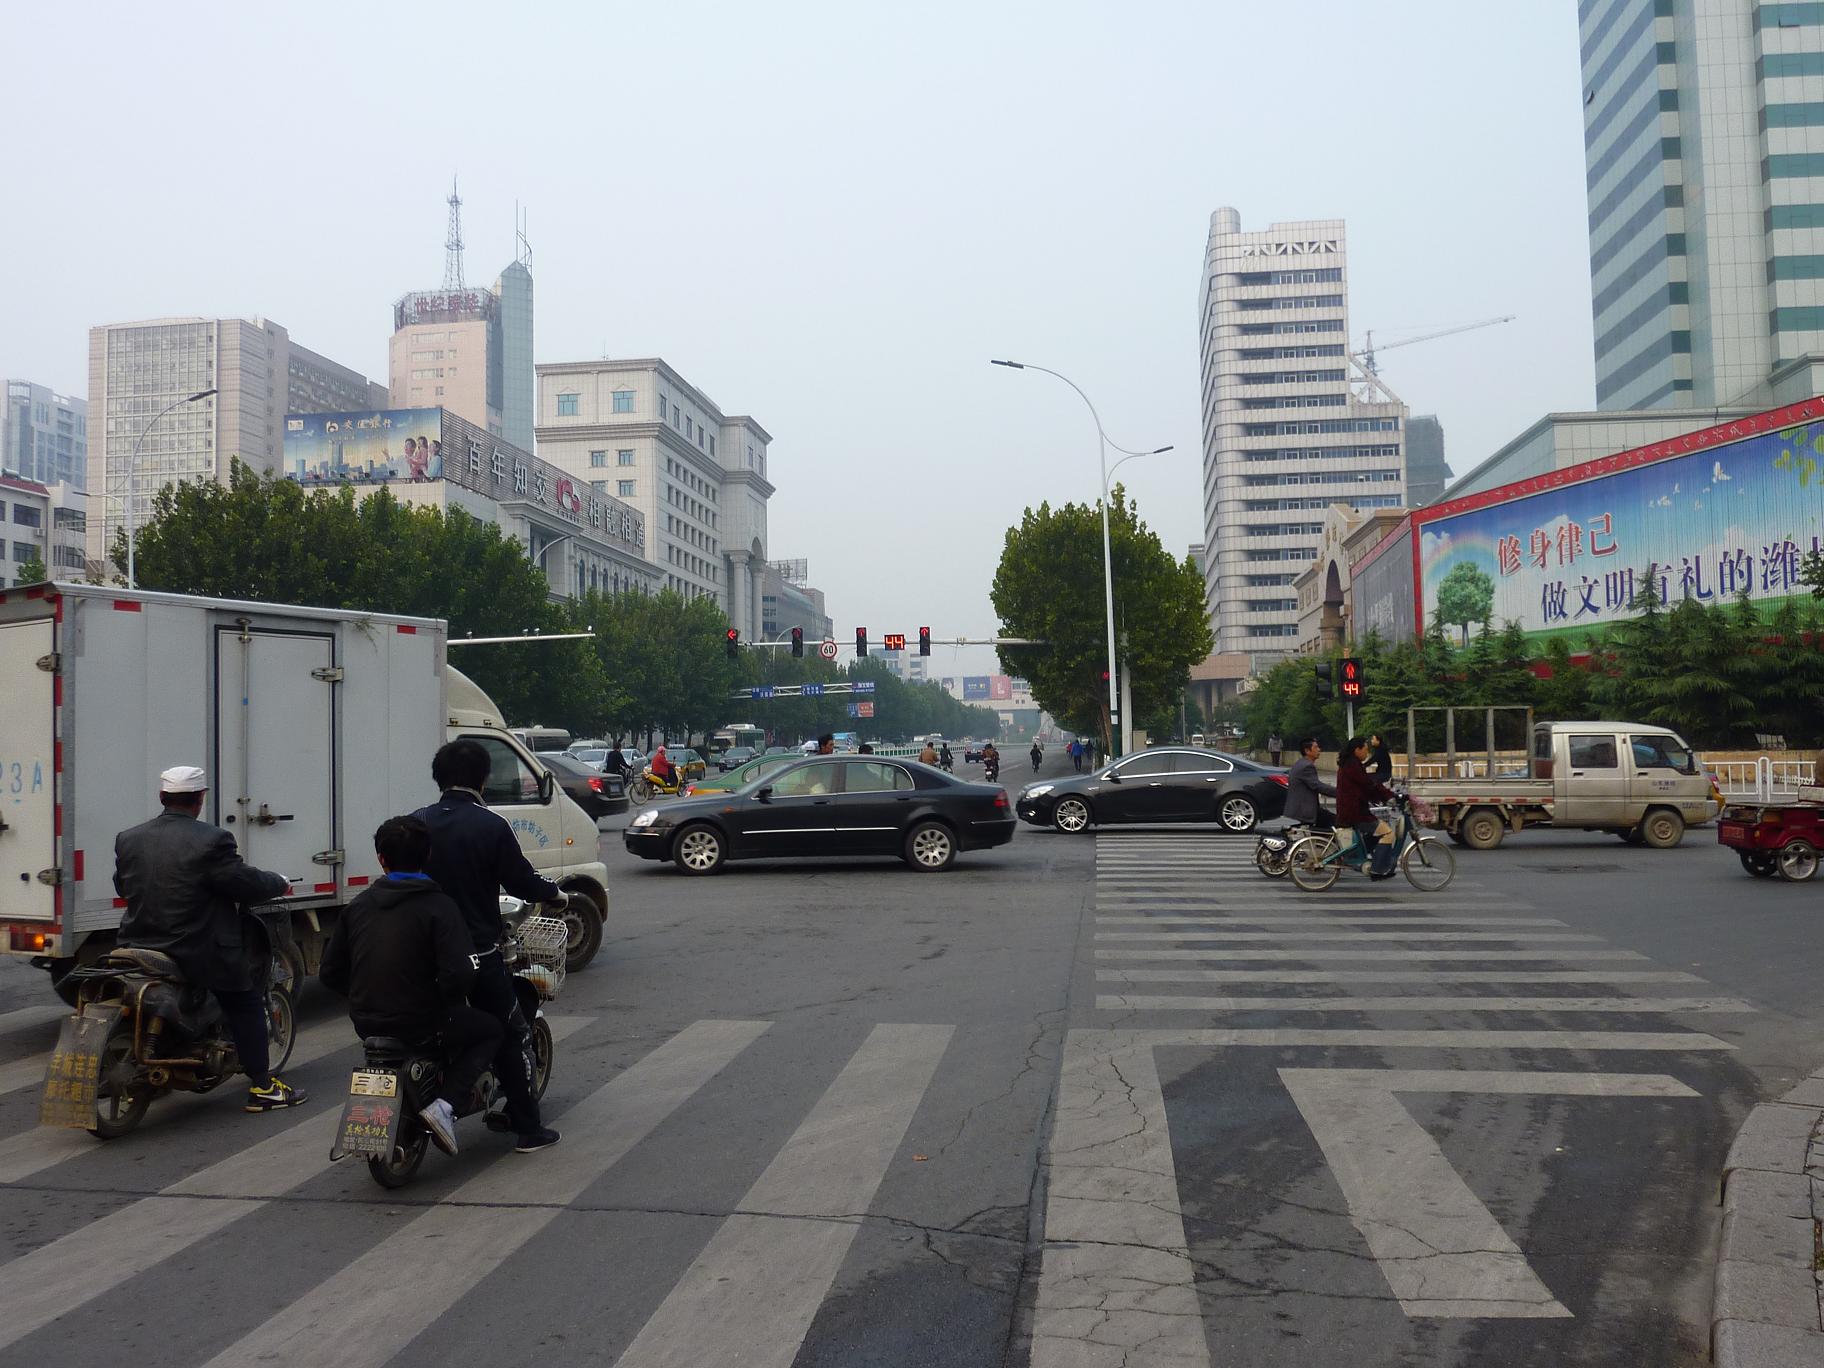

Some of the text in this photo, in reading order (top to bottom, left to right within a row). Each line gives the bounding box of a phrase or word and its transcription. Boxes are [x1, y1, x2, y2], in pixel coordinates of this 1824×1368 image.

[466, 435, 548, 505] 百年知交
[1498, 512, 1618, 576] 修身律己
[1541, 536, 1824, 623] 做文明有礼的潍
[823, 644, 834, 655] 60
[886, 635, 904, 650] 44
[1344, 683, 1359, 695] 44
[0, 761, 43, 794] 3A
